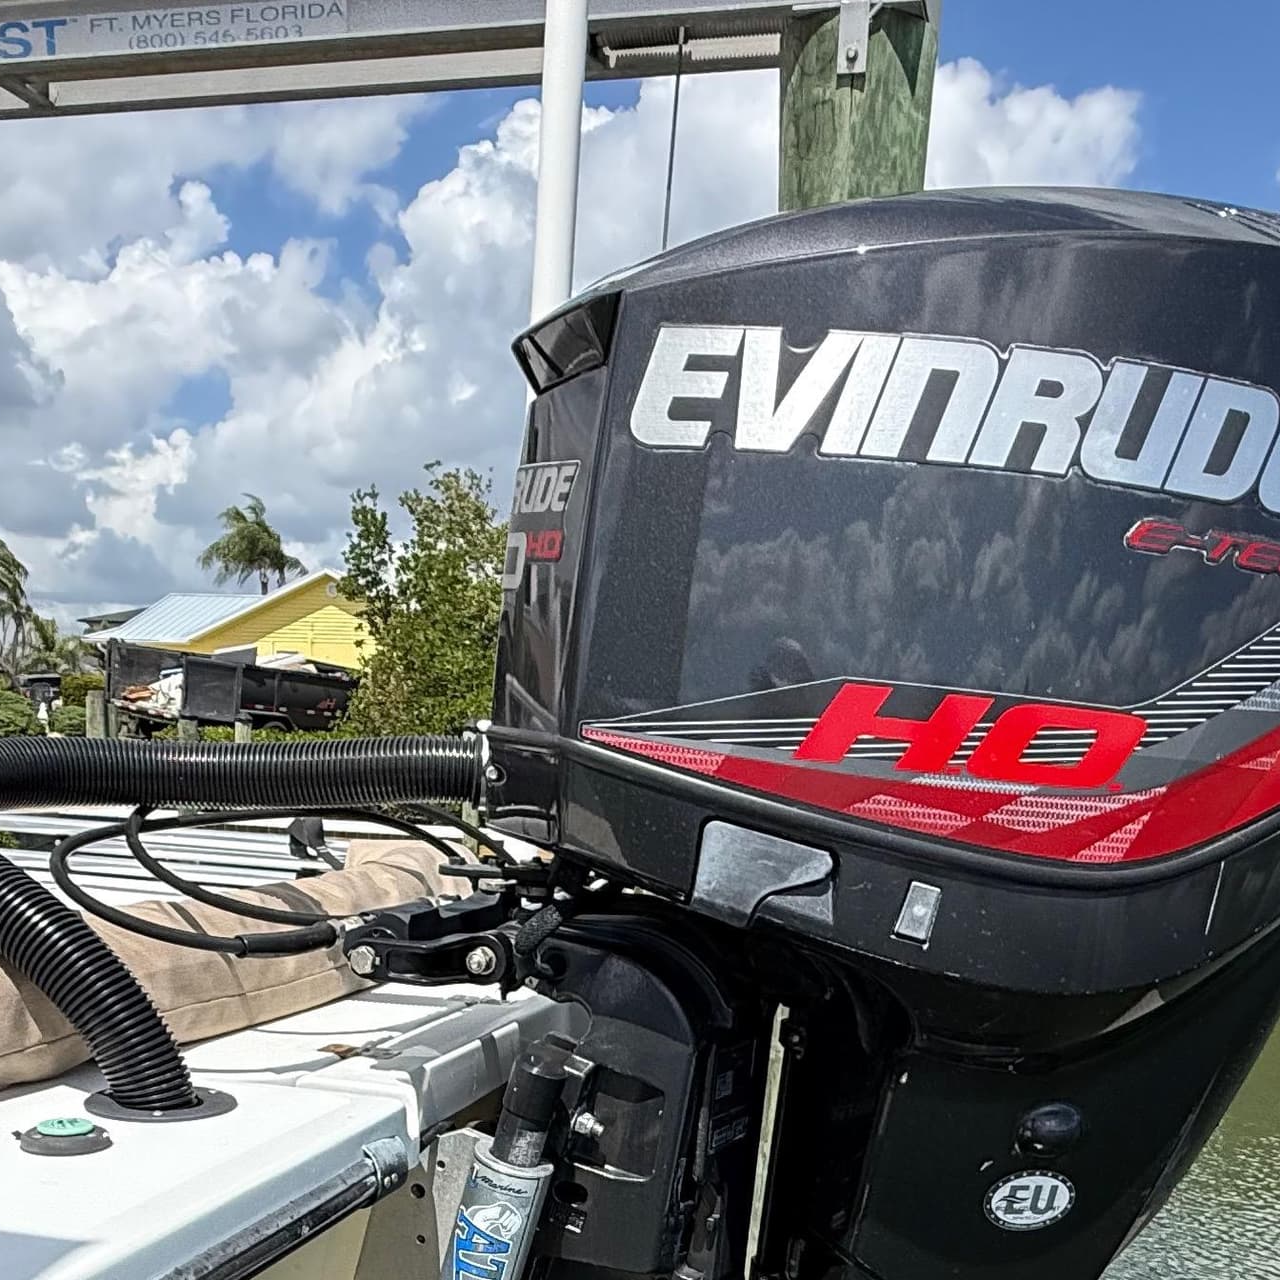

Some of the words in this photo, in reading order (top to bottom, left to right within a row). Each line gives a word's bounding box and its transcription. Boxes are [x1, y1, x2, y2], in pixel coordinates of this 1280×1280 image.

[89, 17, 123, 33] FT.
[131, 10, 220, 31] MYERS
[230, 2, 343, 25] FLORIDA
[128, 32, 186, 50] (800)
